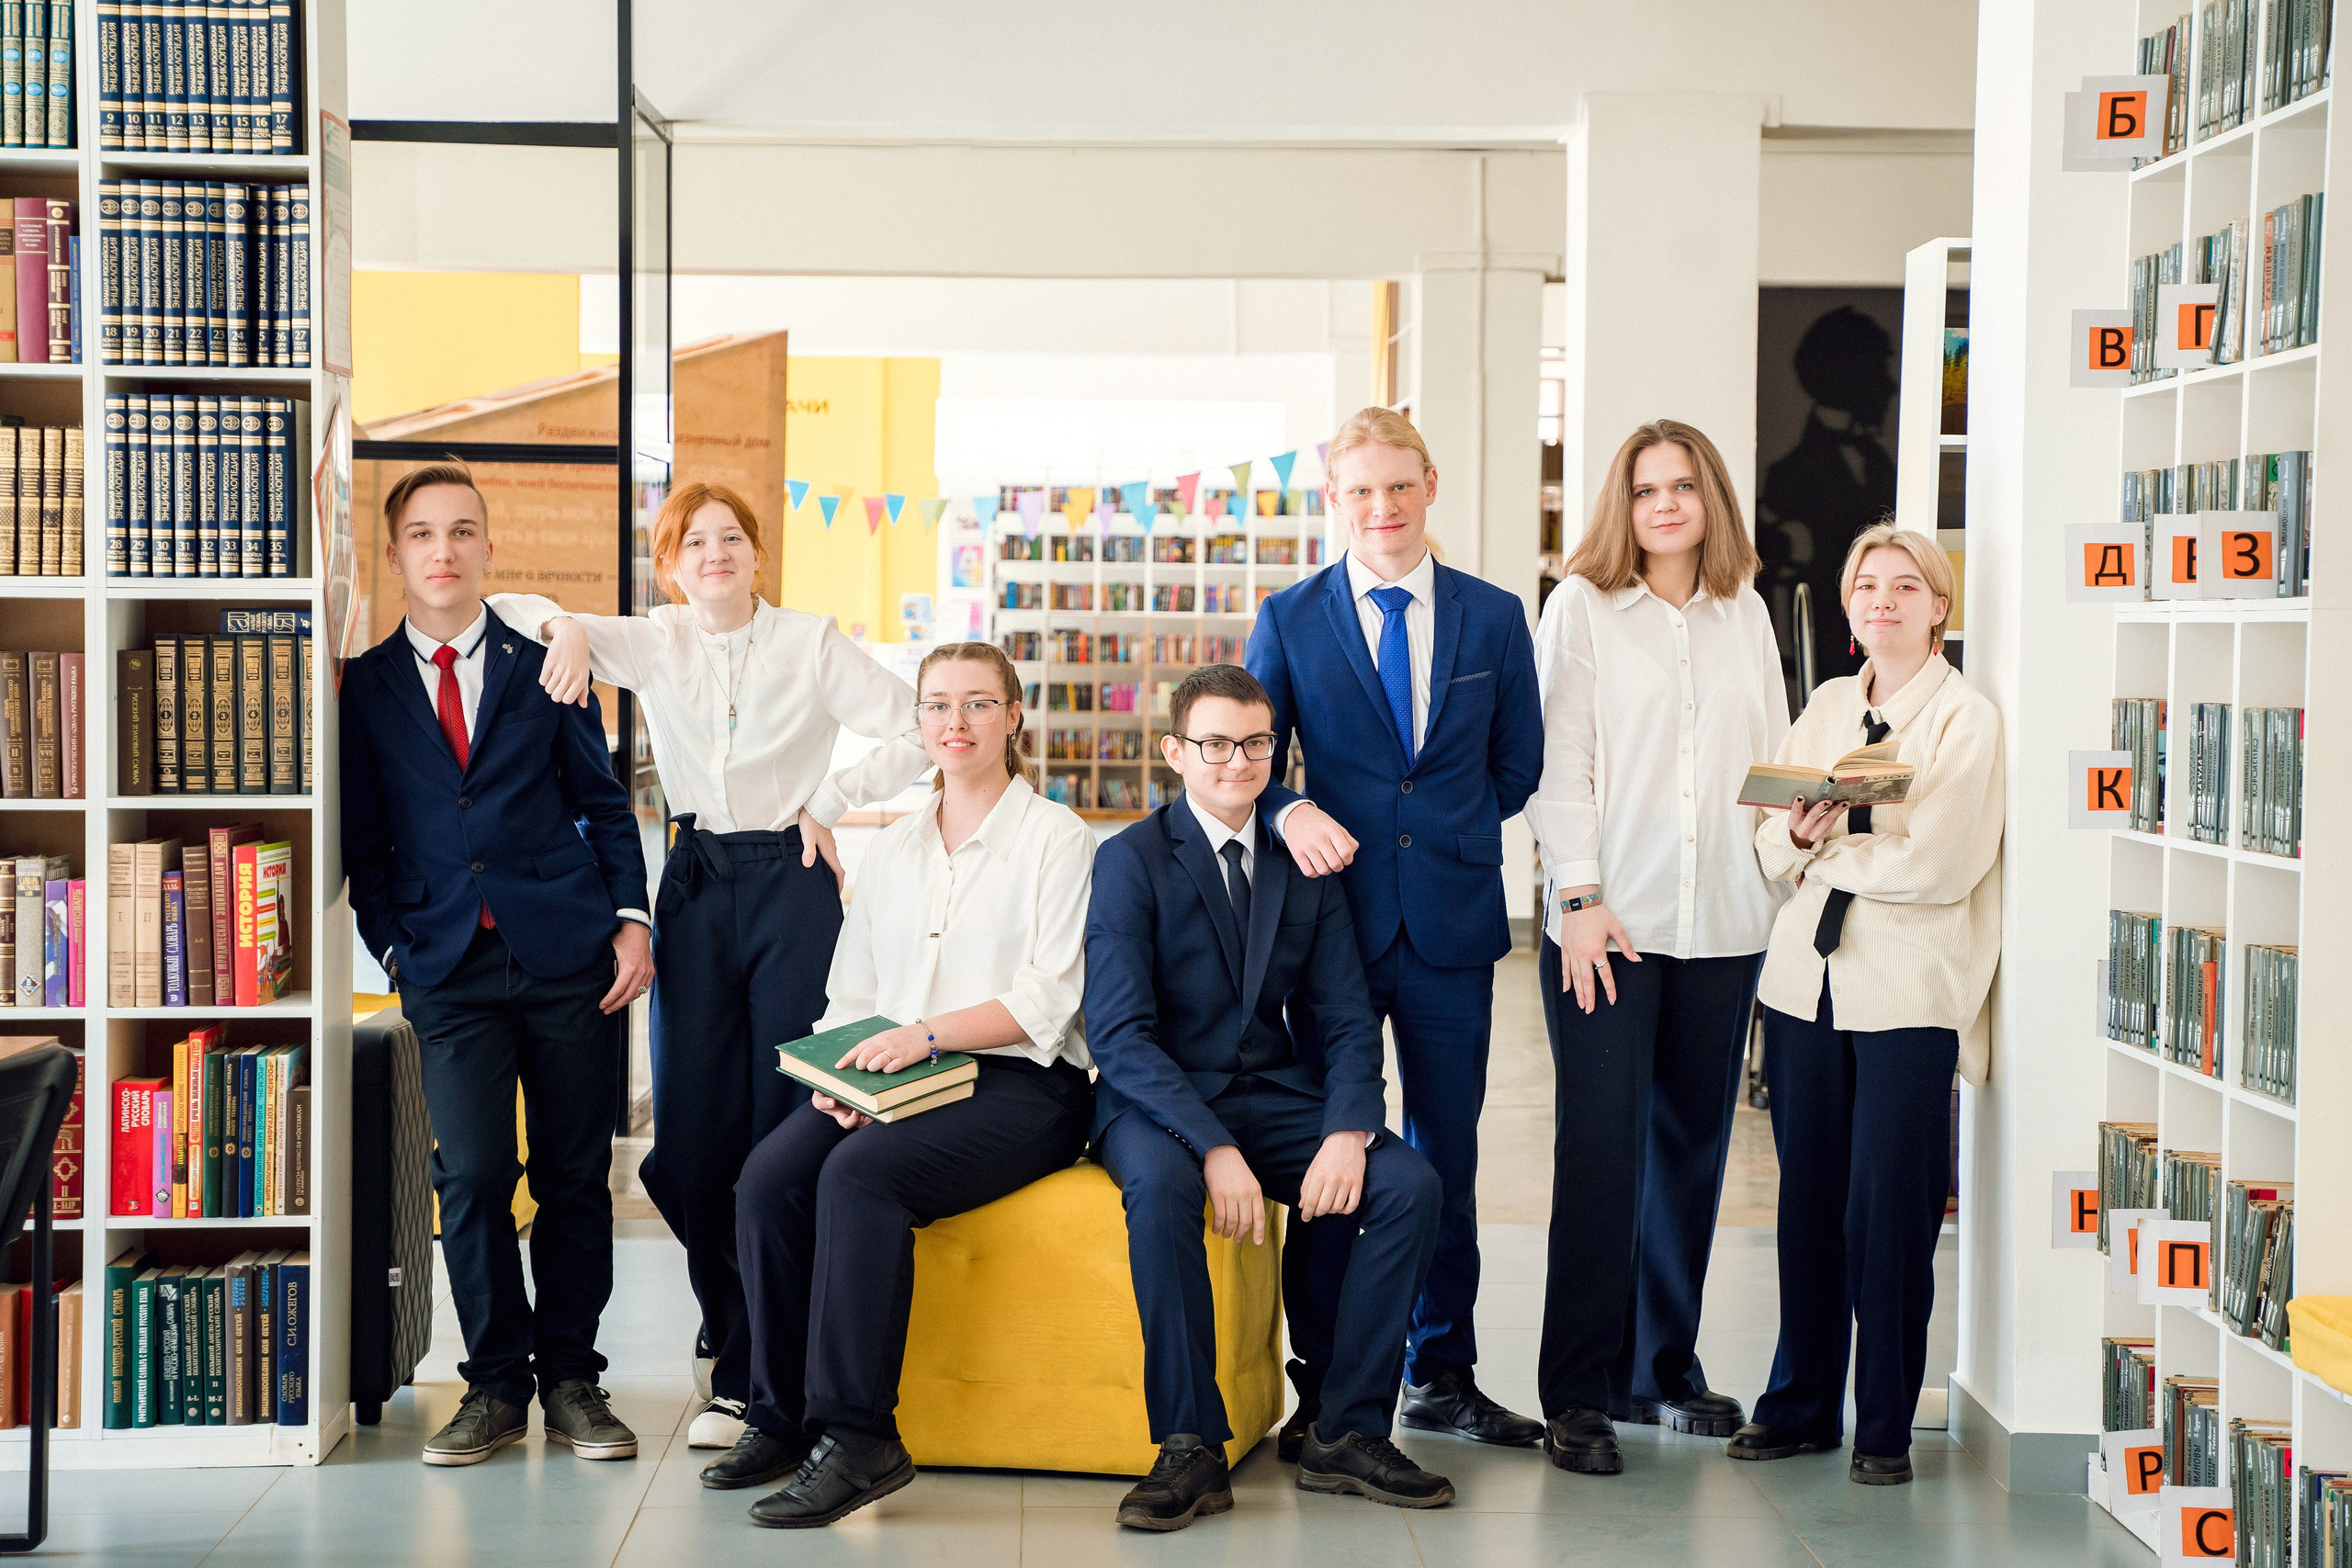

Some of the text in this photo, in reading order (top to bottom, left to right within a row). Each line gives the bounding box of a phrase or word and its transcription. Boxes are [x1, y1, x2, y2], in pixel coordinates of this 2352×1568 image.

[108, 22, 118, 93] ЭНЦИКЛОПЕДИЯ
[195, 24, 205, 96] ЭНЦИКЛОПЕДИЯ
[279, 23, 288, 95] ЭНЦИКЛОПЕДИЯ
[107, 113, 115, 123] 9
[170, 115, 184, 125] 12
[215, 116, 229, 126] 14
[236, 117, 249, 127] 15
[276, 114, 288, 124] 17
[2109, 96, 2136, 138] Б
[109, 237, 119, 307] ЭНЦИКЛОПЕДИЯ
[195, 239, 204, 309] ЭНЦИКЛОПЕДИЯ
[235, 241, 245, 310] ЭНЦИКЛОПЕДИЯ
[300, 241, 309, 310] ЭНЦИКЛОПЕДИЯ
[105, 327, 118, 337] 18
[189, 329, 202, 339] 22
[232, 331, 244, 340] 24
[294, 331, 307, 340] 27
[2099, 328, 2126, 367] В
[115, 450, 124, 519] ЭНЦИКЛОПЕДИЯ
[185, 452, 193, 521] ЭНЦИКЛОПЕДИЯ
[231, 453, 240, 521] ЭНЦИКЛОПЕДИЯ
[275, 453, 284, 522] ЭНЦИКЛОПЕДИЯ
[109, 539, 122, 549] 28
[156, 541, 169, 550] 30
[178, 541, 190, 551] 31
[224, 541, 236, 551] 33
[270, 541, 282, 551] 35
[2233, 533, 2260, 577] З
[2095, 545, 2127, 586] Д
[2251, 738, 2259, 796] КОРОЛЕНКО
[2097, 769, 2125, 809] К
[263, 862, 286, 879] ИСТОРИЯ
[214, 862, 227, 970] ЮРИДИЧЕСКАЯ ЭНЦИКЛОПЕДИЯ
[239, 863, 253, 948] ИСТОРИЯ
[164, 923, 179, 992] ТОЛКОВЫЙ СЛОВАРЬ
[191, 1042, 200, 1070] ФАКТОВ
[191, 1071, 199, 1100] ВАЖНЫХ
[121, 1088, 130, 1133] ЛАТИНСКО-
[130, 1090, 141, 1127] РУССКИЙ
[141, 1089, 151, 1126] СЛОВАРЬ
[2168, 1243, 2200, 1286] П
[139, 1287, 148, 1303] ЯЗЫКА
[139, 1304, 148, 1326] РУССКОГО
[166, 1303, 175, 1325] СЛОВАРЬ
[234, 1314, 243, 1337] ДЕТЕЙ
[260, 1314, 268, 1337] ДЕТЕЙ
[111, 1288, 125, 1404] НОВЫЙ НЕМЕЦКО-РУССКИЙ СЛОВАРЬ
[163, 1329, 171, 1380] НЕМЕЦКО-РУССКИЙ
[170, 1324, 179, 1375] РУССКО-НЕМЕЦКИЙ
[139, 1359, 148, 1379] СЛОВАРЬ
[137, 1379, 147, 1423] ОРФОГРАФИЧЕСКИЙ
[2138, 1450, 2163, 1491] Р
[2193, 1445, 2202, 1487] ОМАНОВЫ
[2195, 1510, 2228, 1556] С
